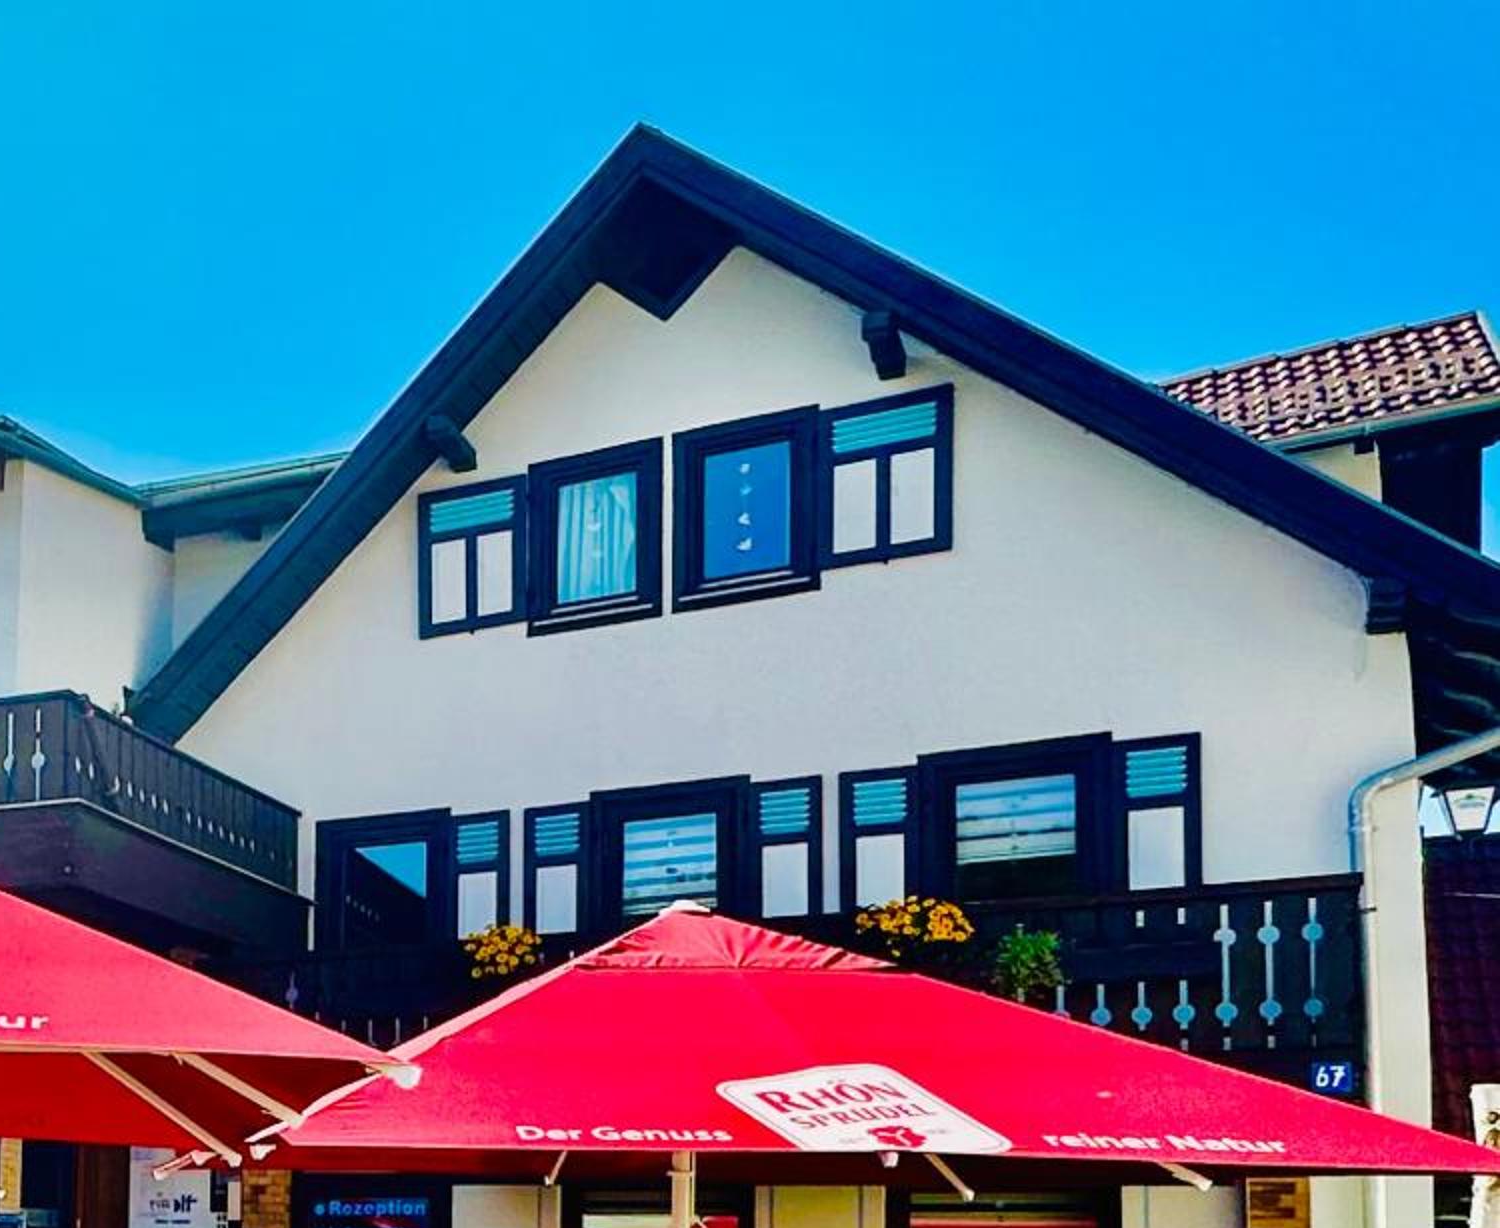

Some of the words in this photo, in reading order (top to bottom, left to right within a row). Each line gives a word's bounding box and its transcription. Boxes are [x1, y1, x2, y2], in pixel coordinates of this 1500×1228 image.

[1316, 1065, 1346, 1088] 67
[754, 1079, 908, 1114] RHÖN
[790, 1103, 938, 1129] SPRUDEL
[515, 1125, 582, 1140] Der
[591, 1125, 732, 1142] Genuss
[1042, 1133, 1161, 1150] reiner
[1164, 1134, 1285, 1153] Natur
[328, 1200, 425, 1217] Rezeption
